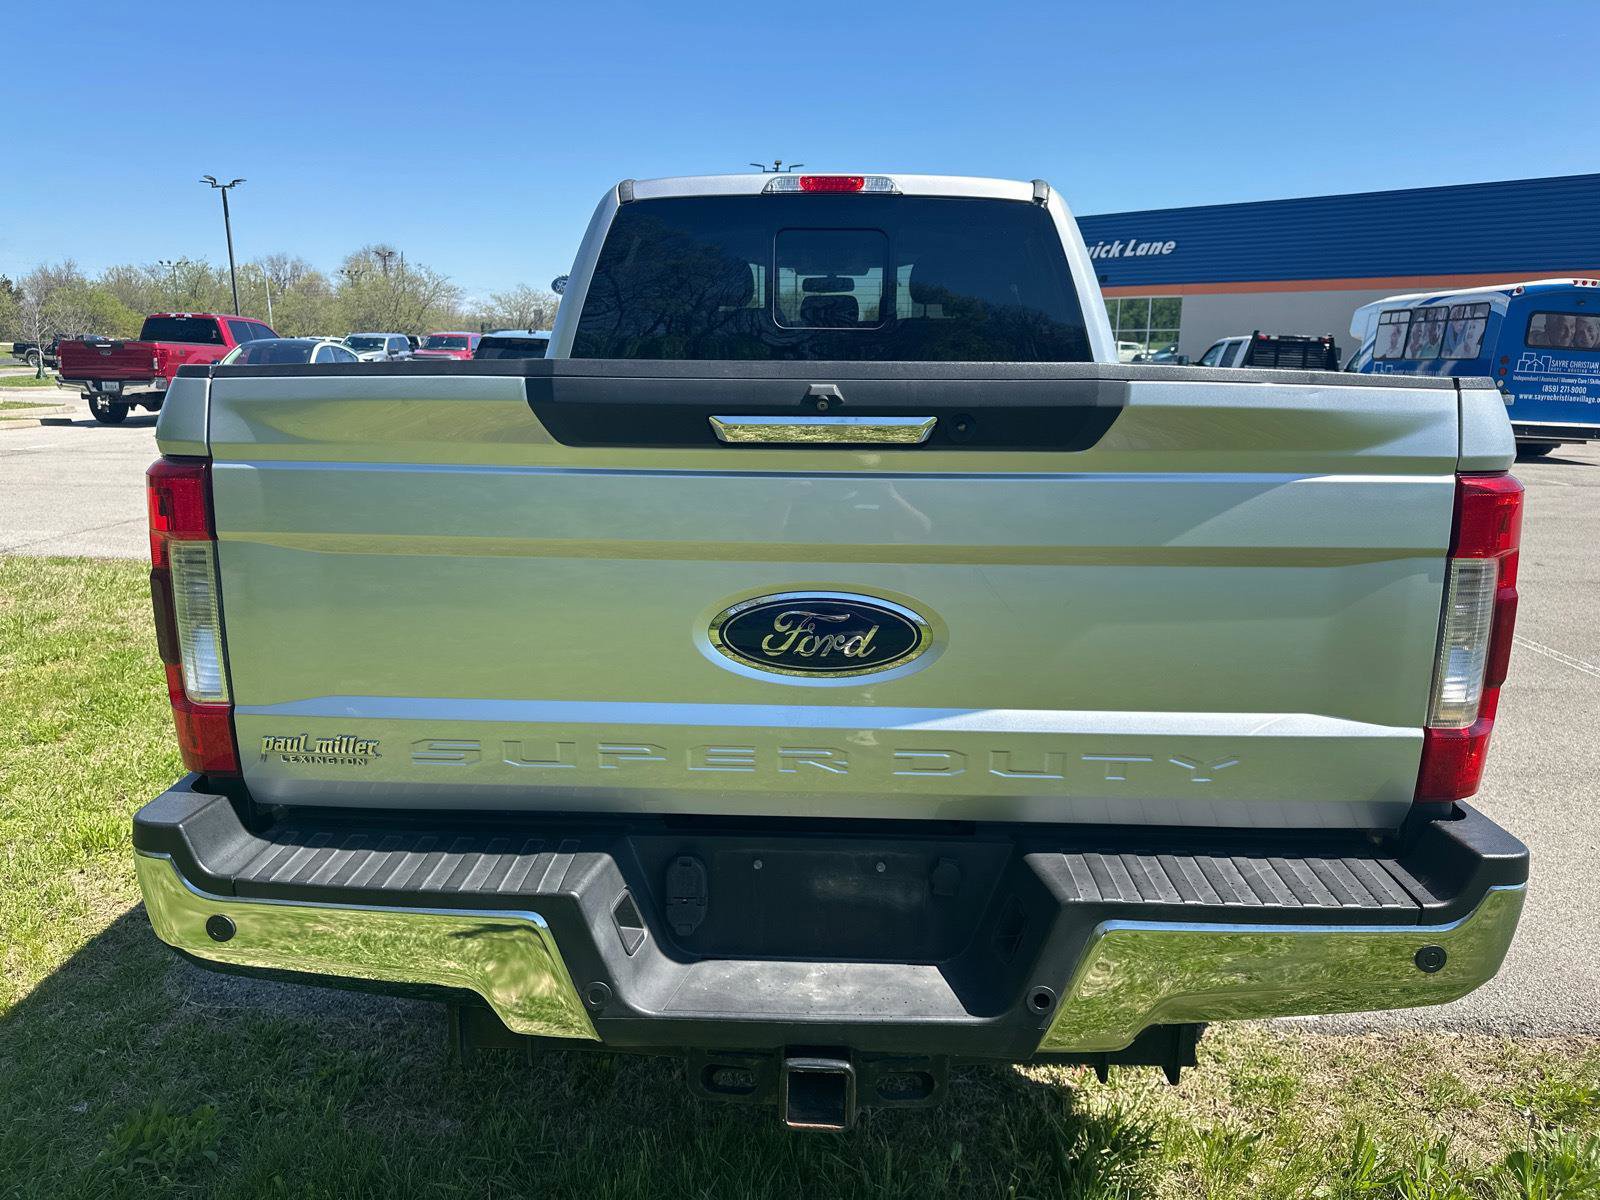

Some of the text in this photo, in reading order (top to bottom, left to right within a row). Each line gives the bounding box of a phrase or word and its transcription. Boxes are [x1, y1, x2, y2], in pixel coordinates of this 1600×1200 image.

[1087, 239, 1176, 259] uick Lane
[1551, 359, 1600, 370] SAYRE CHRISTIAN
[1542, 384, 1587, 394] (859) 271-9000
[761, 610, 880, 658] Ford
[260, 733, 382, 761] paul miller
[279, 754, 368, 766] LEXINGTON
[410, 738, 1240, 783] SUPER DUTY
